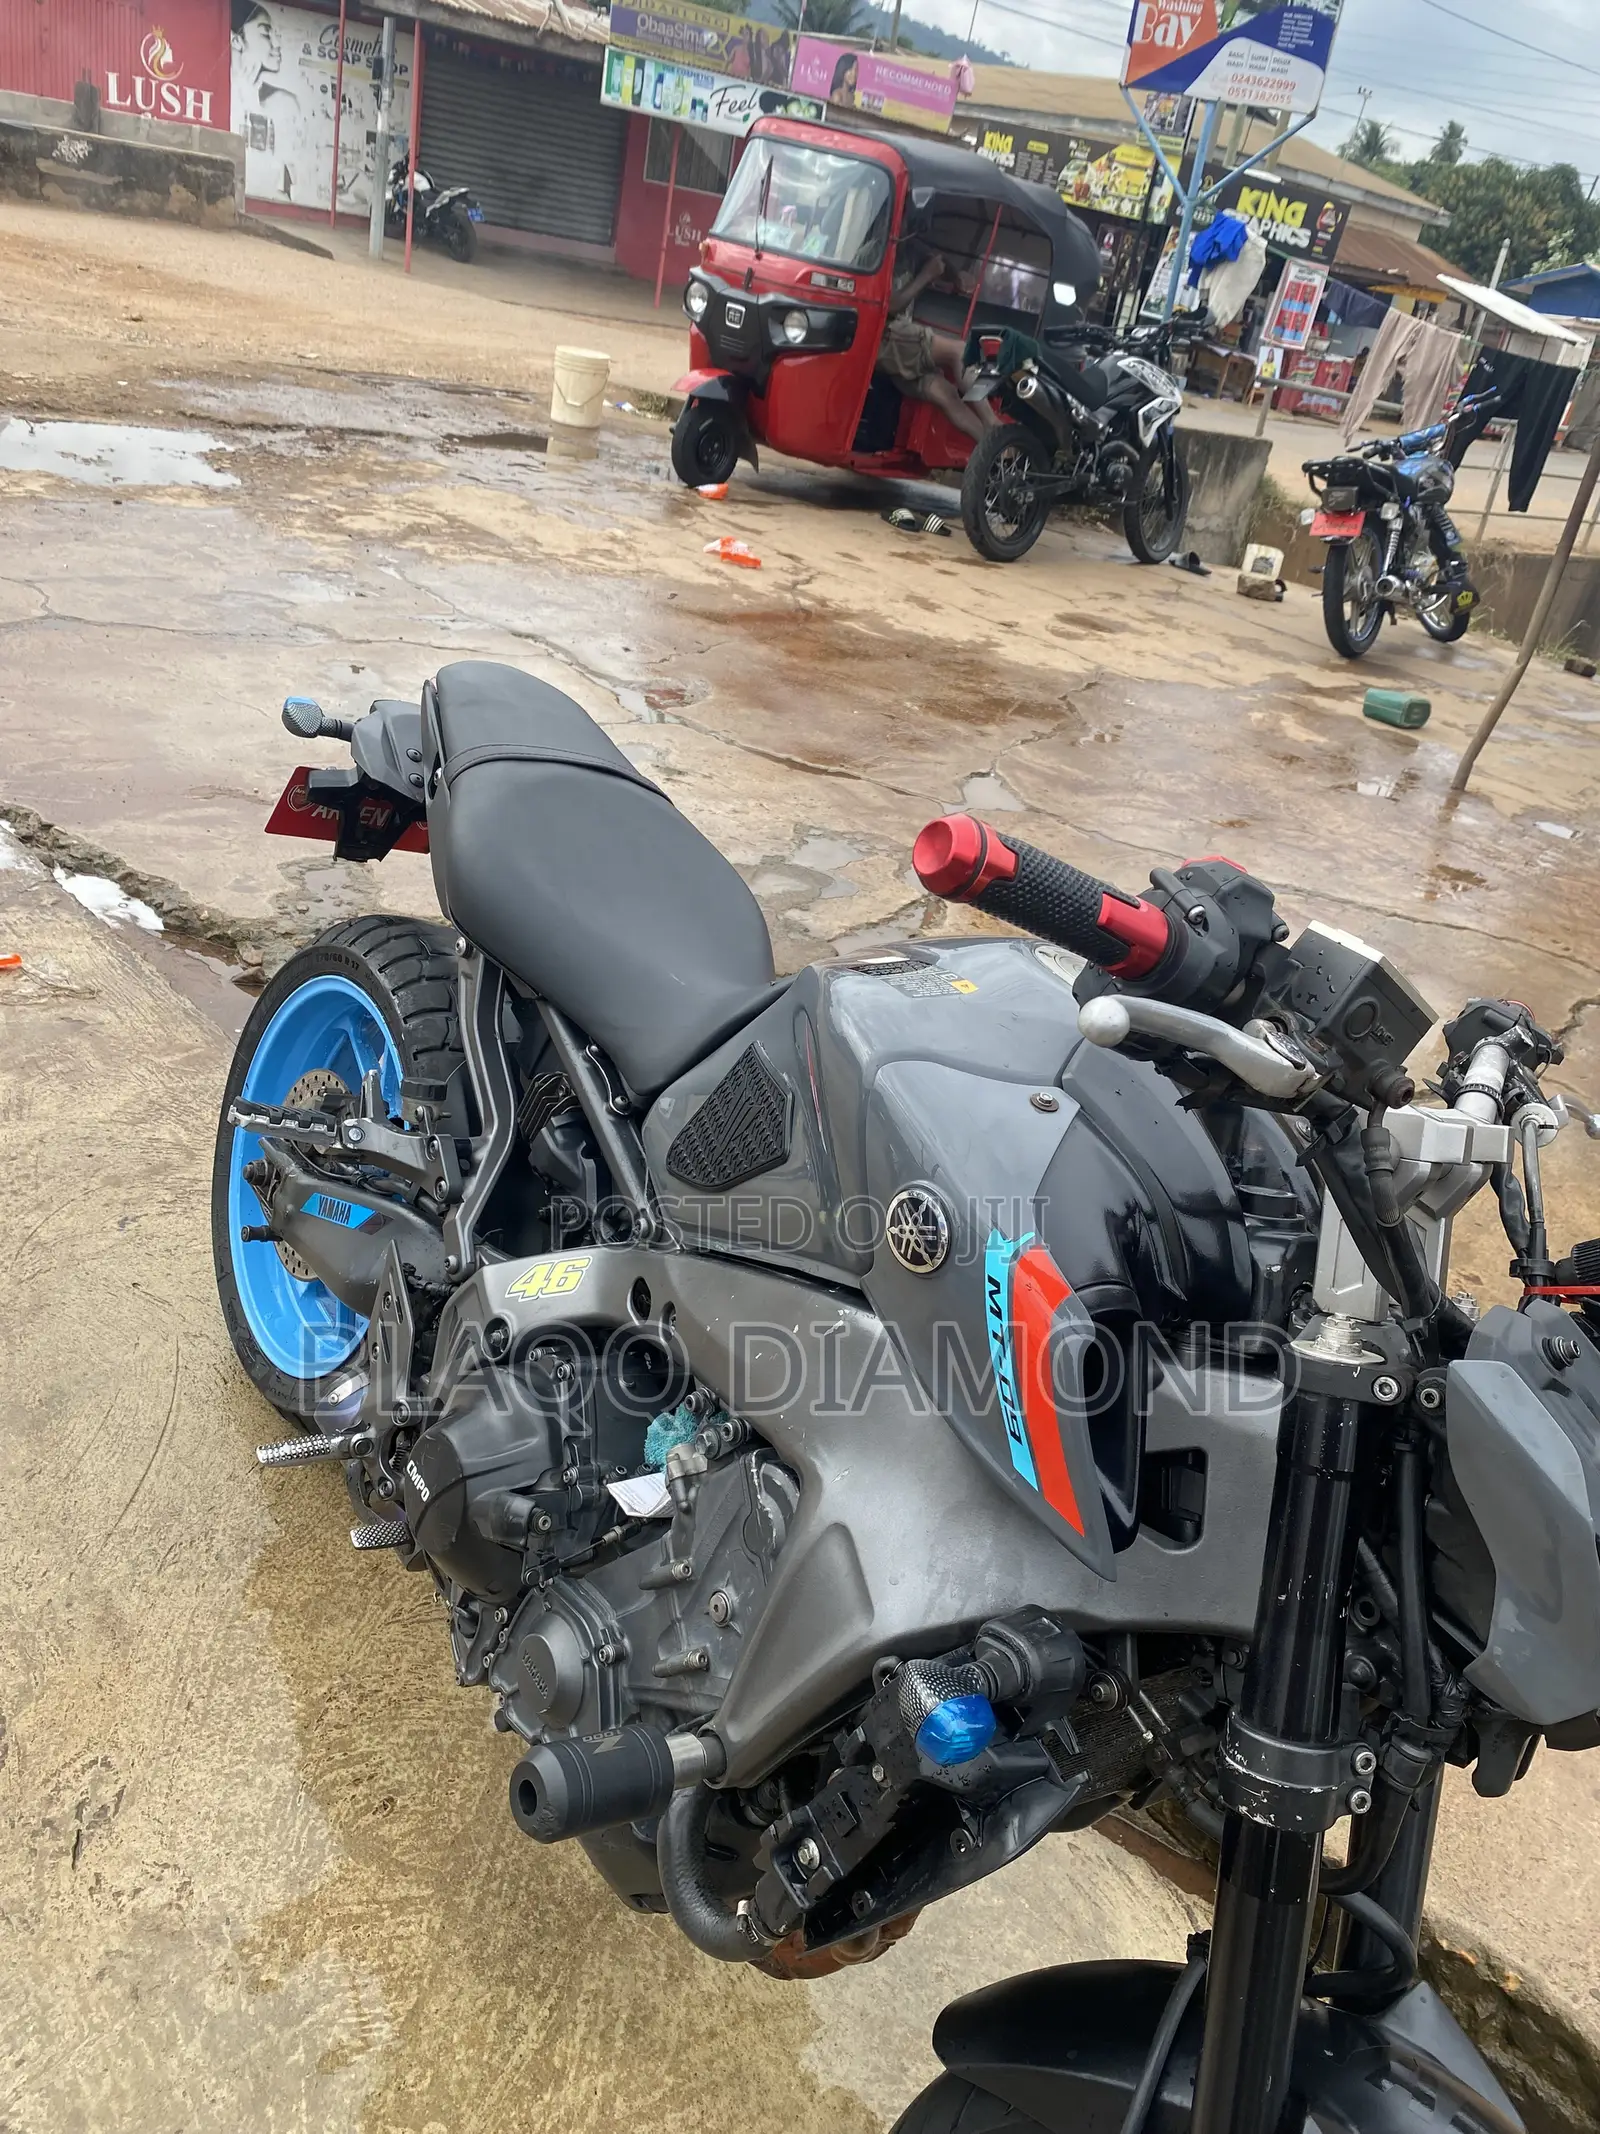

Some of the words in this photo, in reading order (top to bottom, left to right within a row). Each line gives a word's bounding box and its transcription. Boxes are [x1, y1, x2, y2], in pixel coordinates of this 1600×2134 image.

[302, 43, 312, 55] &
[1132, 3, 1202, 50] Bay
[105, 70, 214, 123] LUSH
[710, 84, 758, 117] Feel
[1236, 186, 1308, 229] KING
[318, 1195, 353, 1226] YAMAHA
[505, 1256, 593, 1302] 46
[987, 1274, 1024, 1447] MT-09
[521, 1648, 549, 1700] YAMAHA
